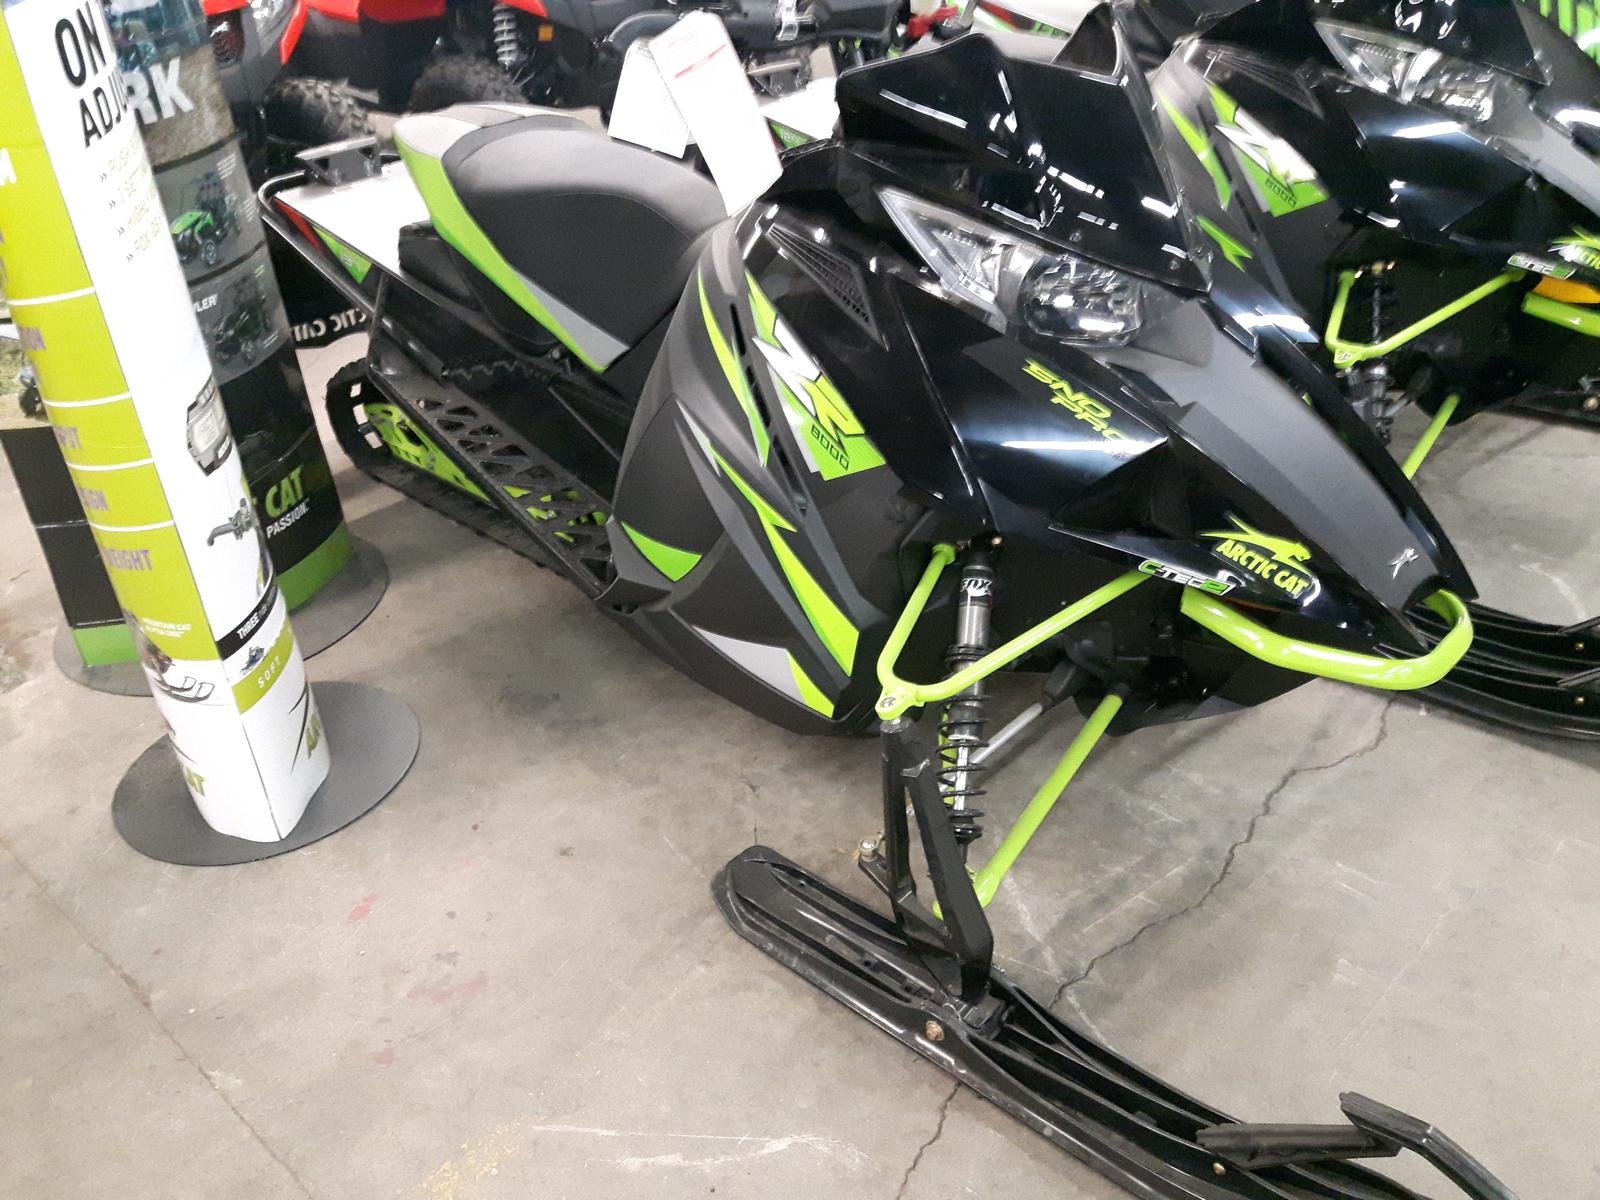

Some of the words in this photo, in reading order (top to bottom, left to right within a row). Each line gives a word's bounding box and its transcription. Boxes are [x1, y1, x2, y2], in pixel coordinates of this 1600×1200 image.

[120, 56, 194, 125] RK
[811, 423, 850, 472] 8000
[265, 467, 305, 518] CAT
[1216, 539, 1279, 579] ARCTIC
[1273, 569, 1309, 597] CAT
[258, 655, 280, 689] SOFT
